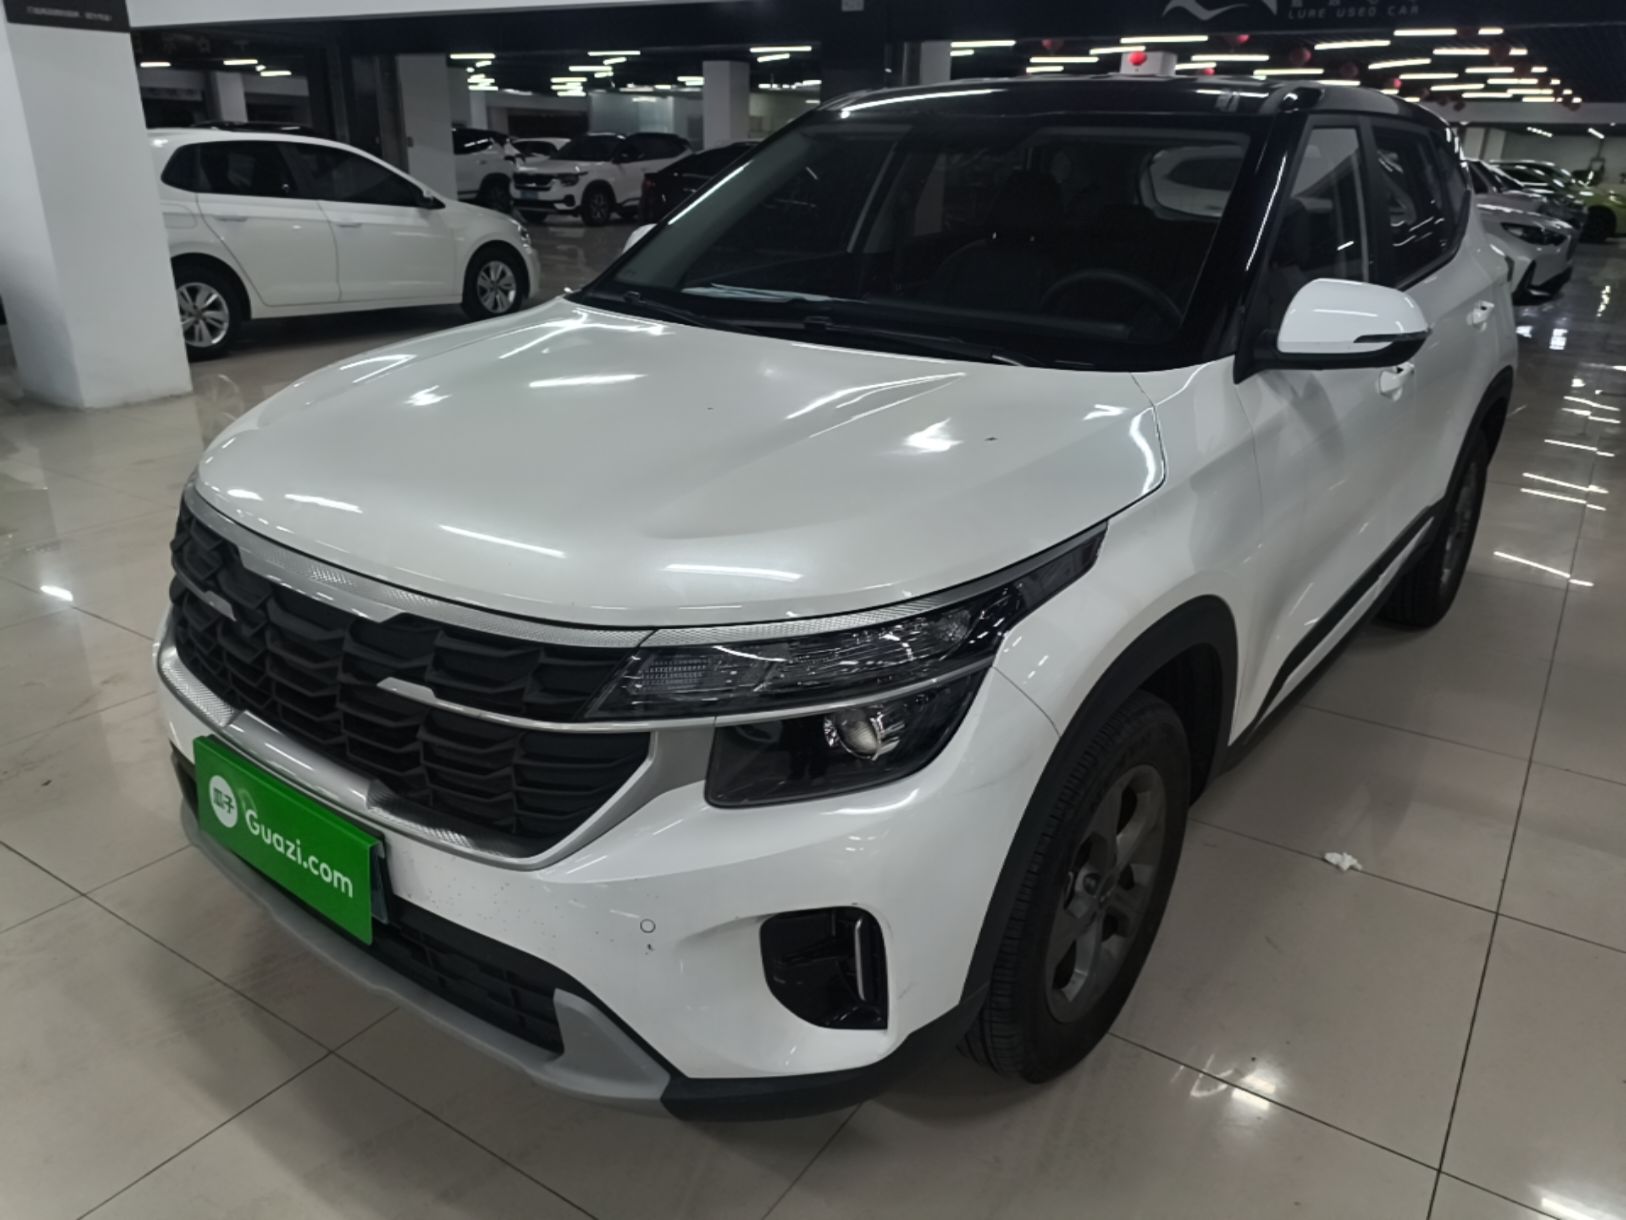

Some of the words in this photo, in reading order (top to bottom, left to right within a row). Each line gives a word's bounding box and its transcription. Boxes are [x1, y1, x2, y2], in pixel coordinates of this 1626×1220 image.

[1335, 6, 1377, 18] USED
[1387, 5, 1419, 17] CAR
[245, 809, 353, 898] Guazi.com
